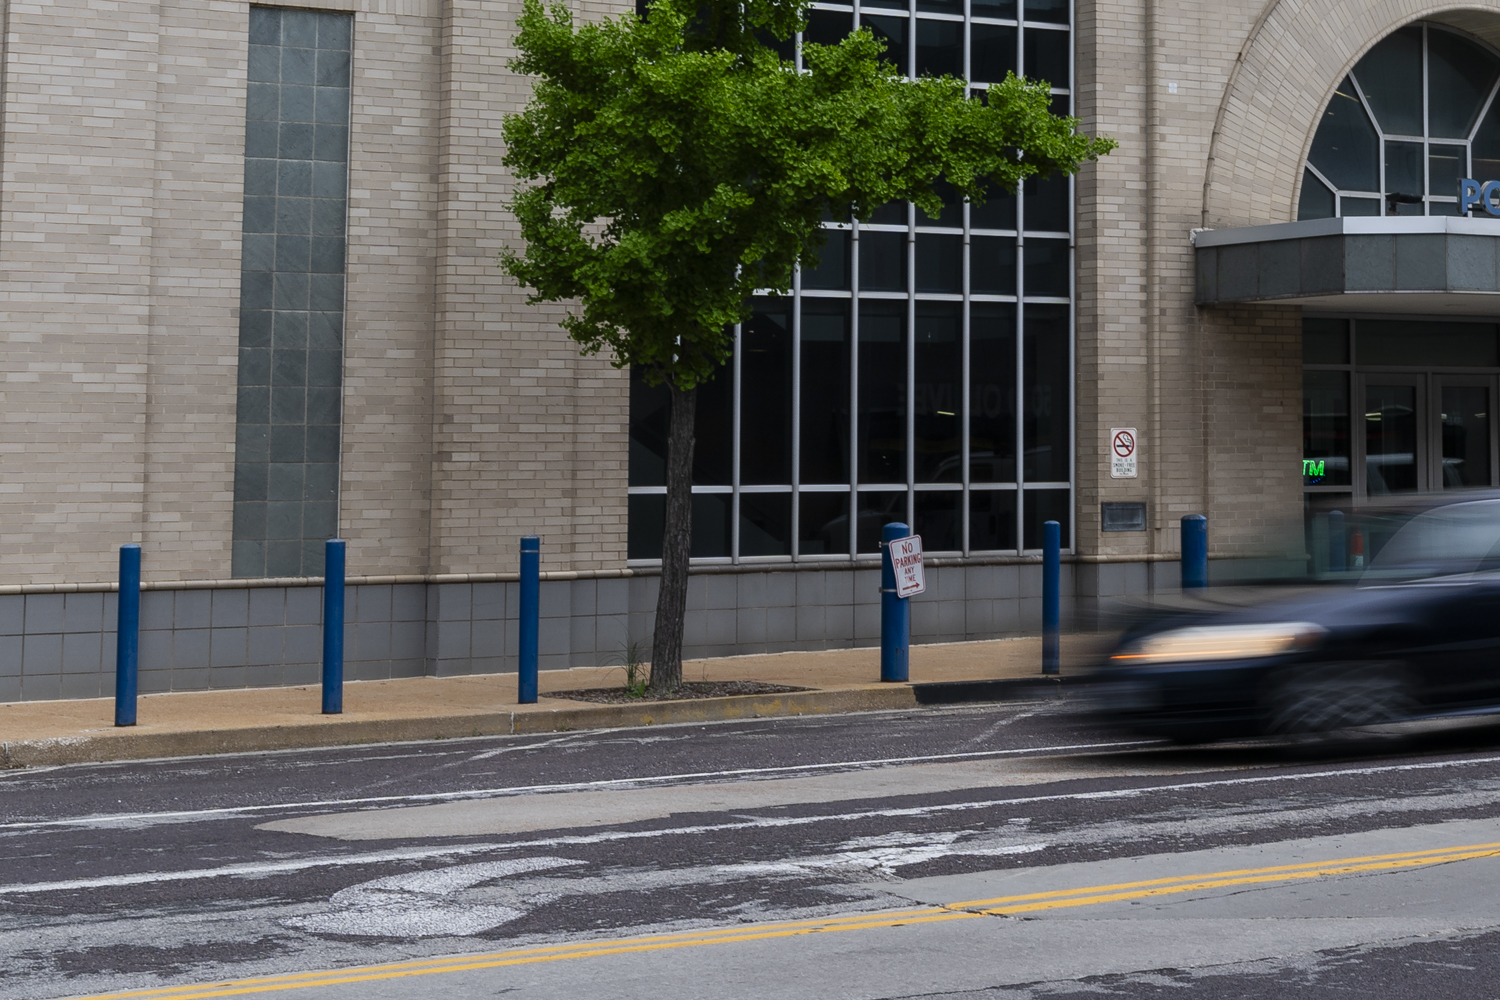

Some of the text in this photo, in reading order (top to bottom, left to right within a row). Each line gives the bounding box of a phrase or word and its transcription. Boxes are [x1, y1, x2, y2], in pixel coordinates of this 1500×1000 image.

[901, 543, 913, 555] NO
[894, 553, 922, 569] PARKING
[904, 566, 915, 575] ANY
[904, 574, 917, 584] TIME
